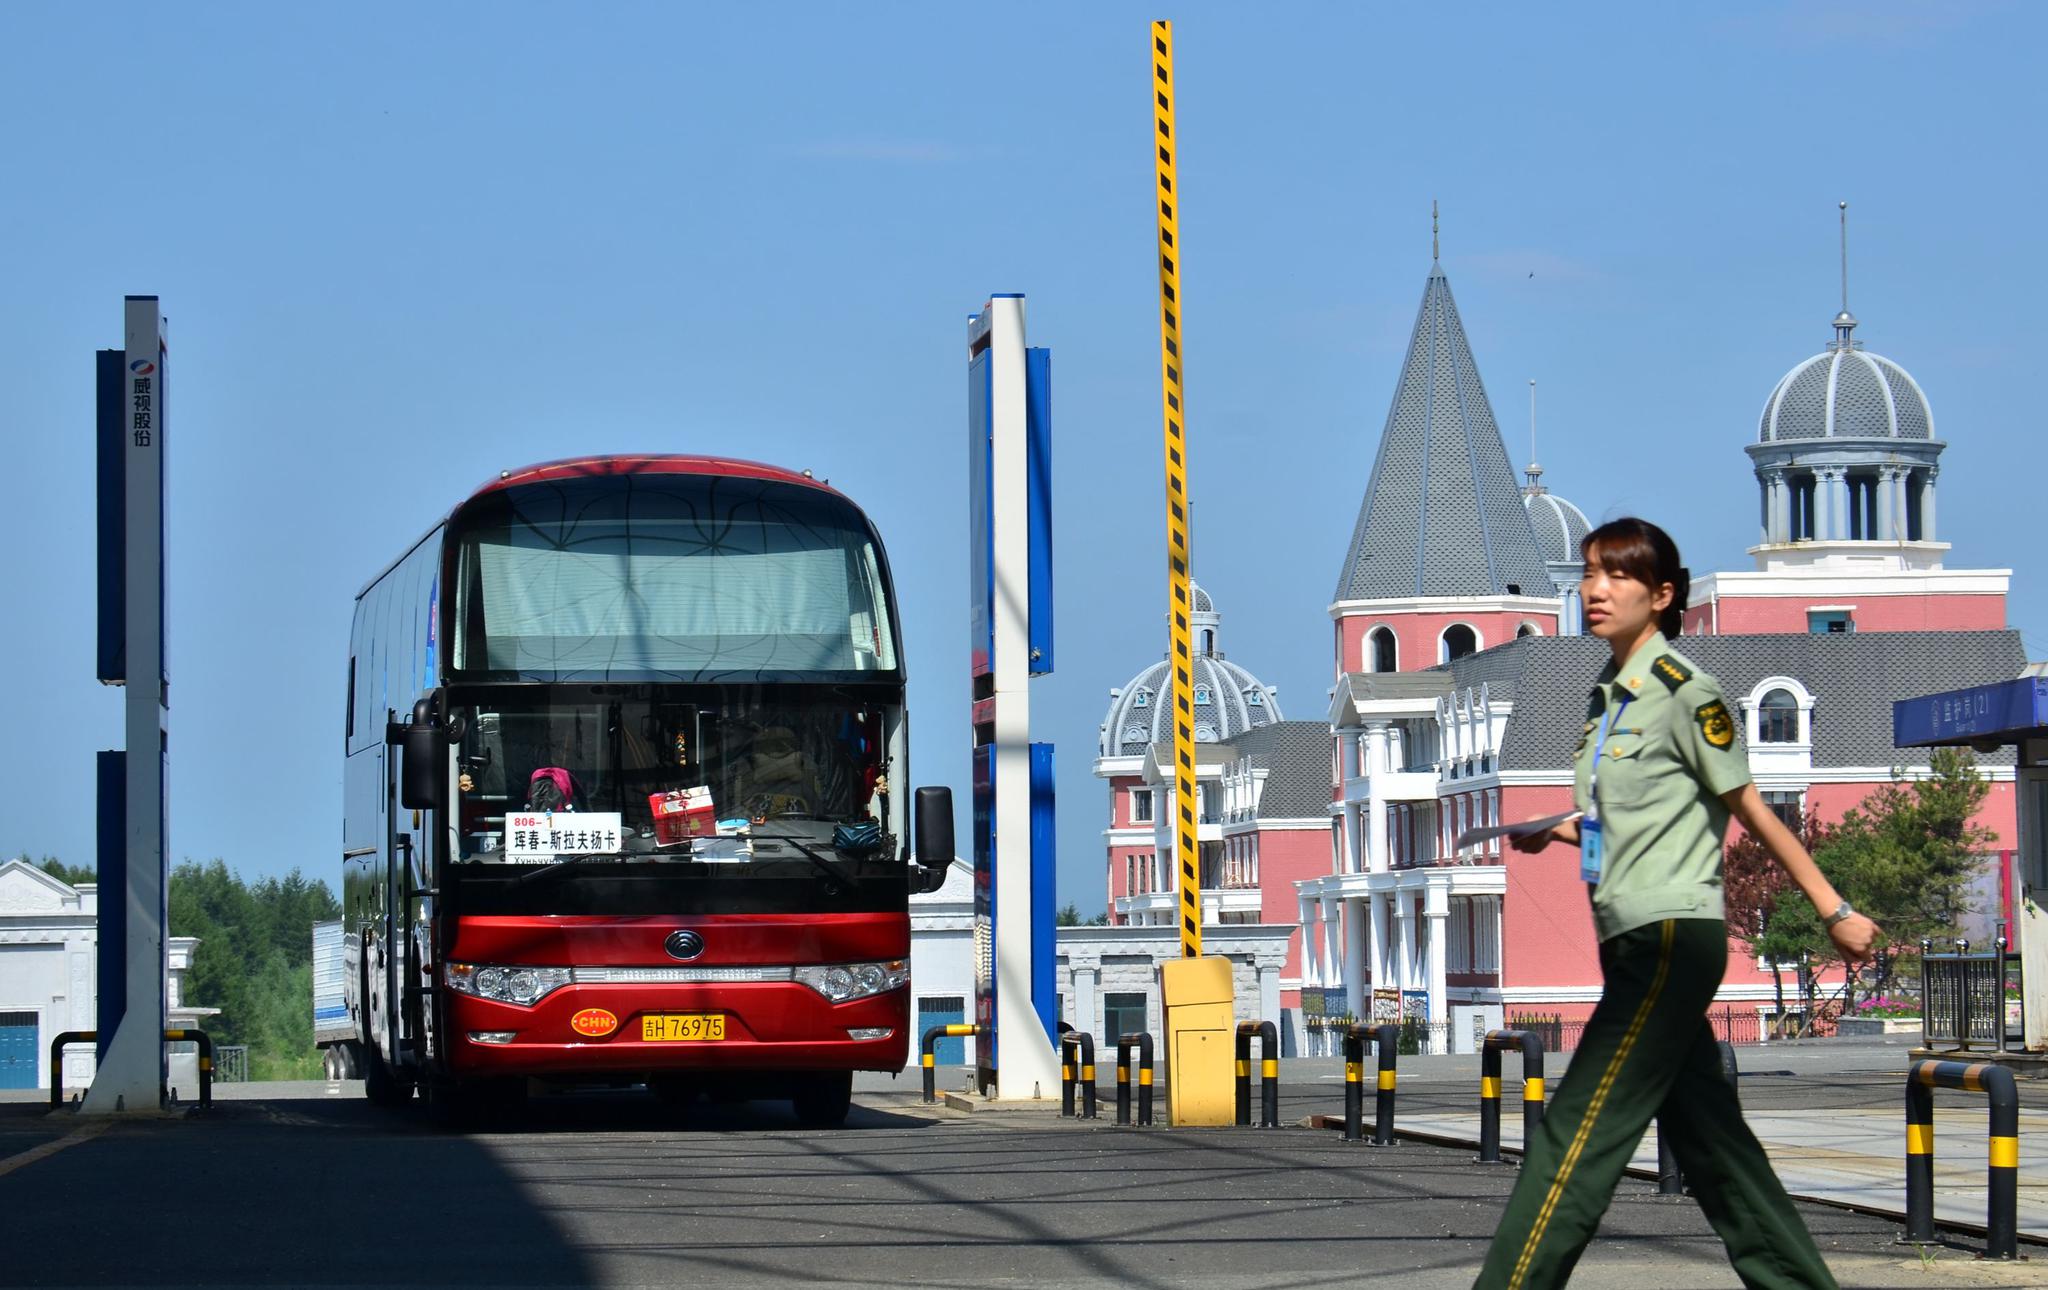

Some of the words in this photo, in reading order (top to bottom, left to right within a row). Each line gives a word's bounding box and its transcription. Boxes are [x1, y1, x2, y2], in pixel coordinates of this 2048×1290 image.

[133, 377, 151, 447] 威视股份
[514, 830, 616, 850] 珲春-斯拉夫扬卡
[578, 1016, 611, 1028] CHN
